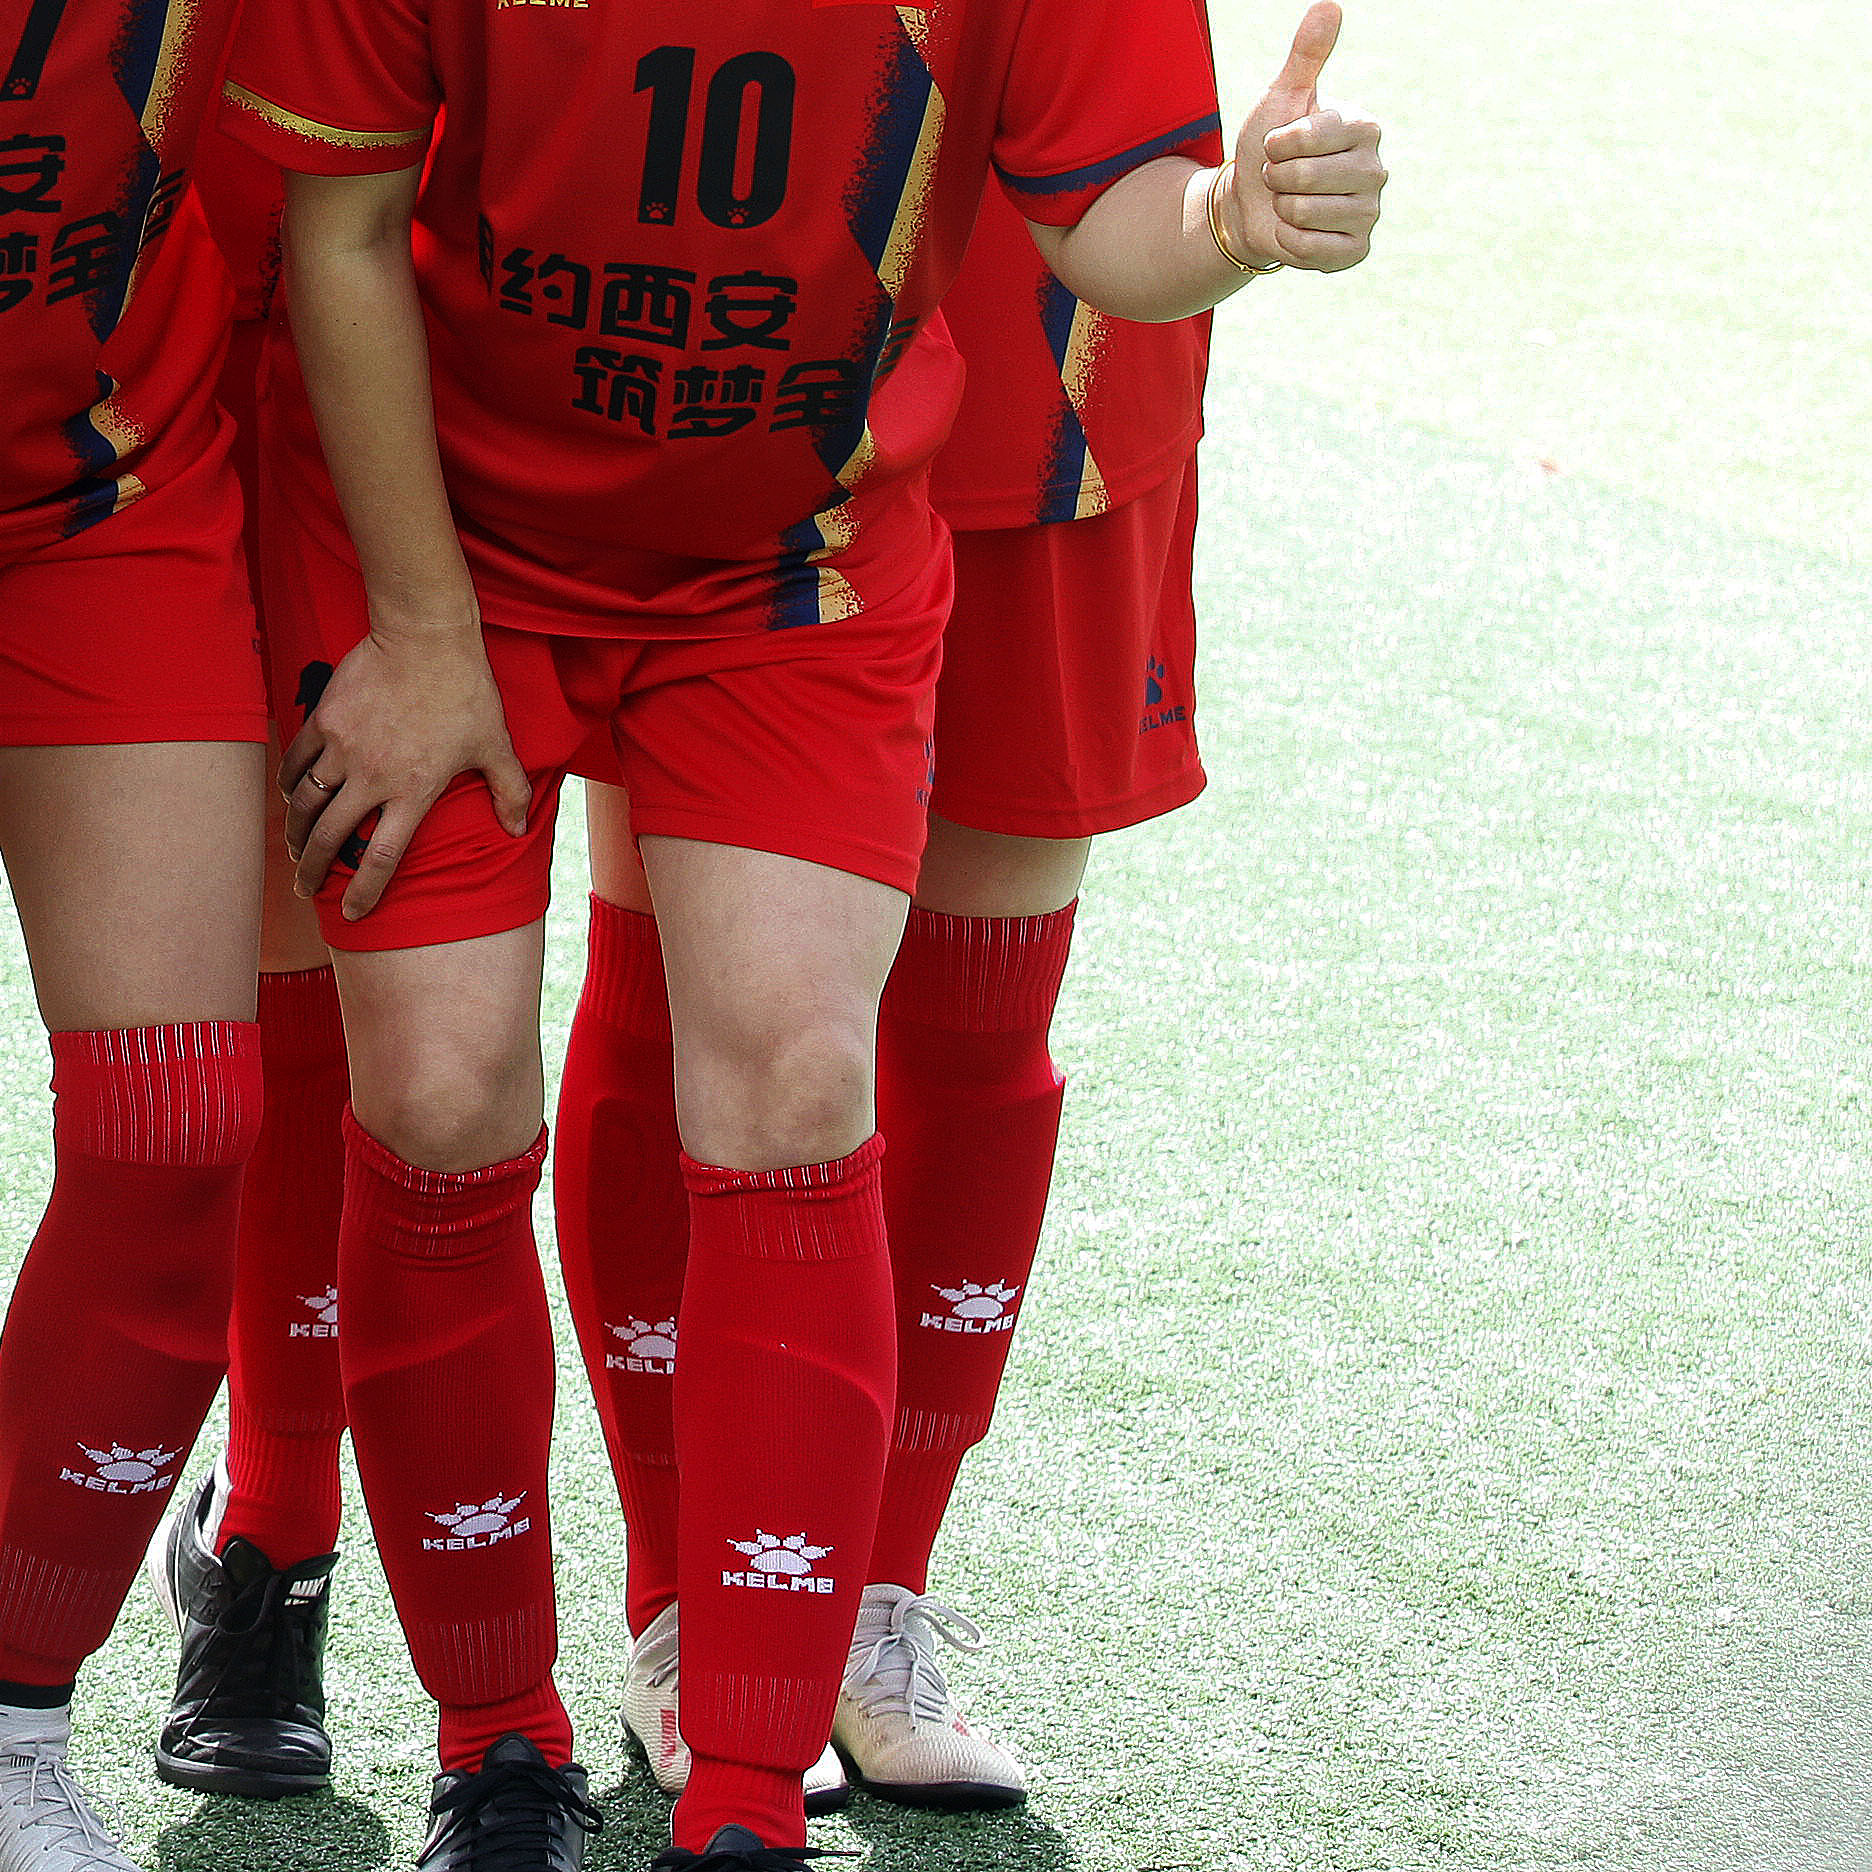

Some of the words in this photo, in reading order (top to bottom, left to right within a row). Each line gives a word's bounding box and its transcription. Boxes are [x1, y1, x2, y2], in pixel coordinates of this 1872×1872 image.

[632, 45, 796, 228] 10
[920, 1311, 1013, 1333] KELME
[605, 1353, 675, 1374] KEL
[60, 1468, 173, 1496] KELME
[422, 1519, 529, 1550] KELME
[289, 1574, 334, 1597] NIK
[723, 1569, 834, 1595] KELME
